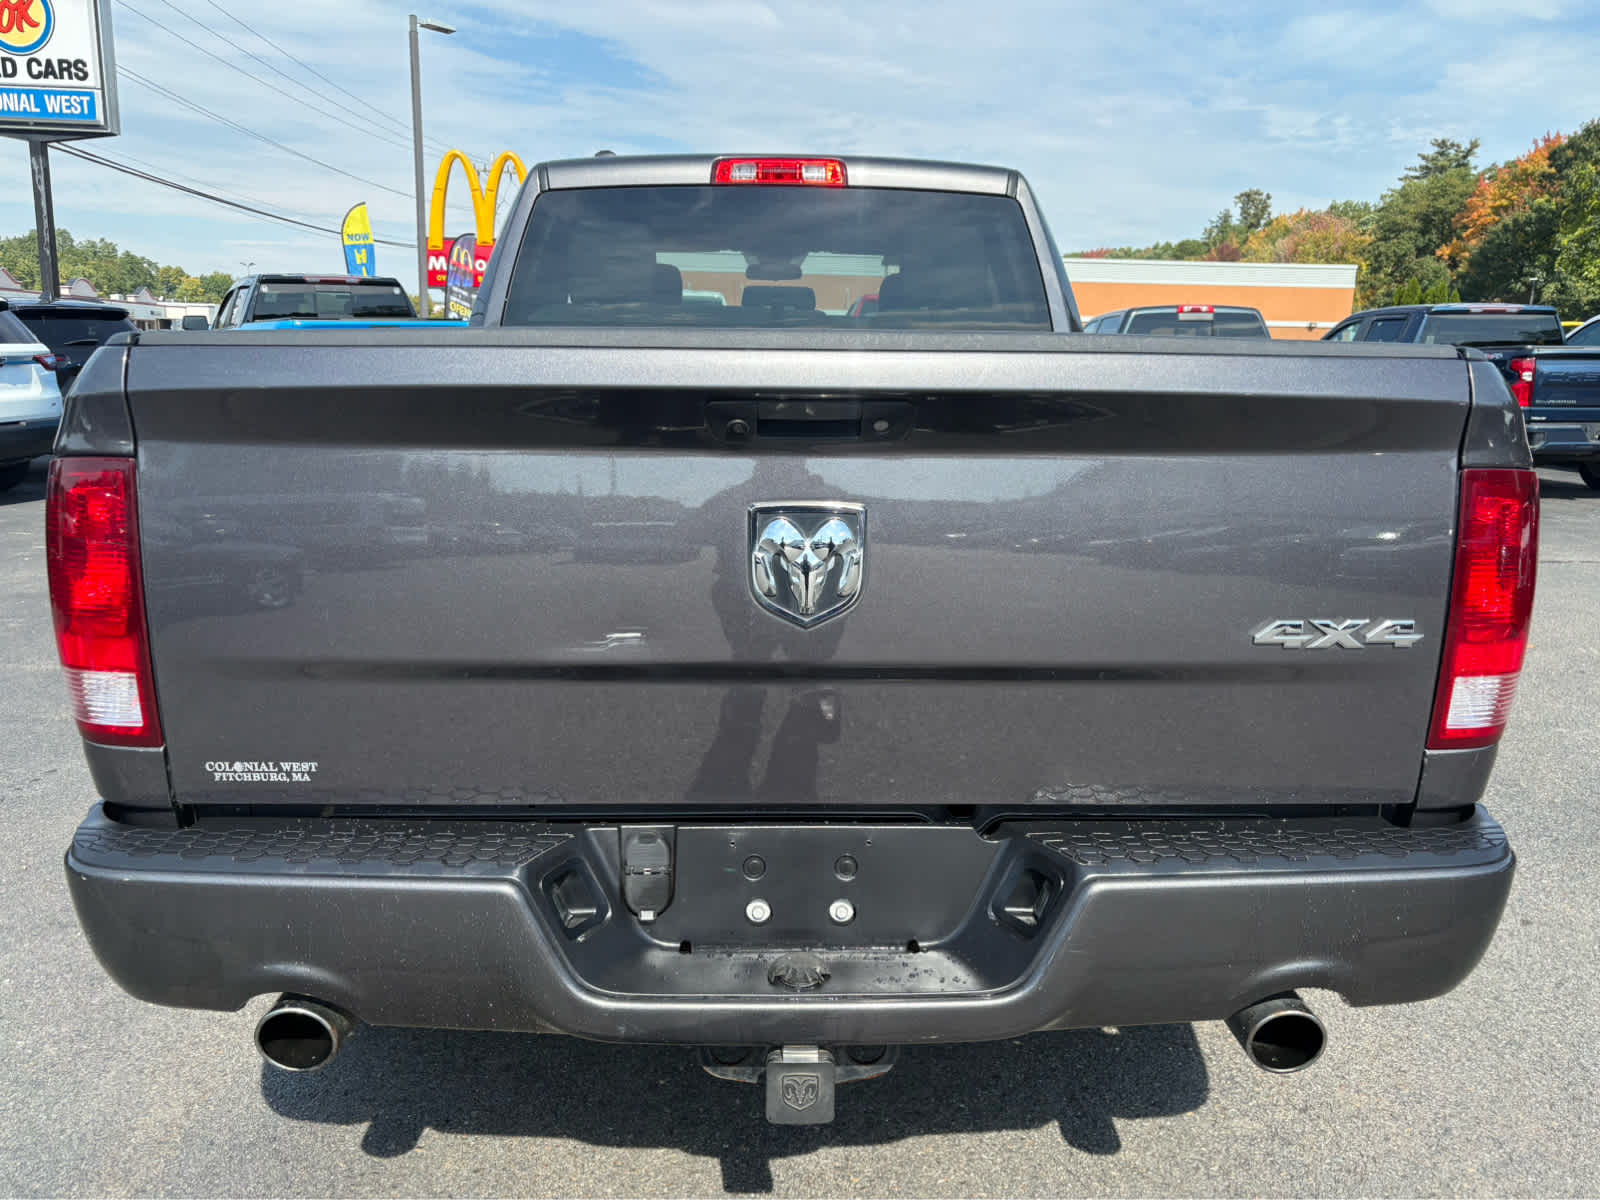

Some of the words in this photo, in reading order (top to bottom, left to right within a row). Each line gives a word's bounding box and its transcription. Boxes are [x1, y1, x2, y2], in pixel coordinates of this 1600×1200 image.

[0, 57, 18, 78] D
[26, 57, 89, 81] CARS
[0, 92, 41, 113] NIAL
[44, 94, 91, 115] WEST
[347, 233, 369, 242] NOW
[205, 761, 278, 772] COLONIAL
[279, 761, 318, 772] WEST
[214, 772, 290, 783] FITCHBURG,
[291, 772, 311, 782] MA
